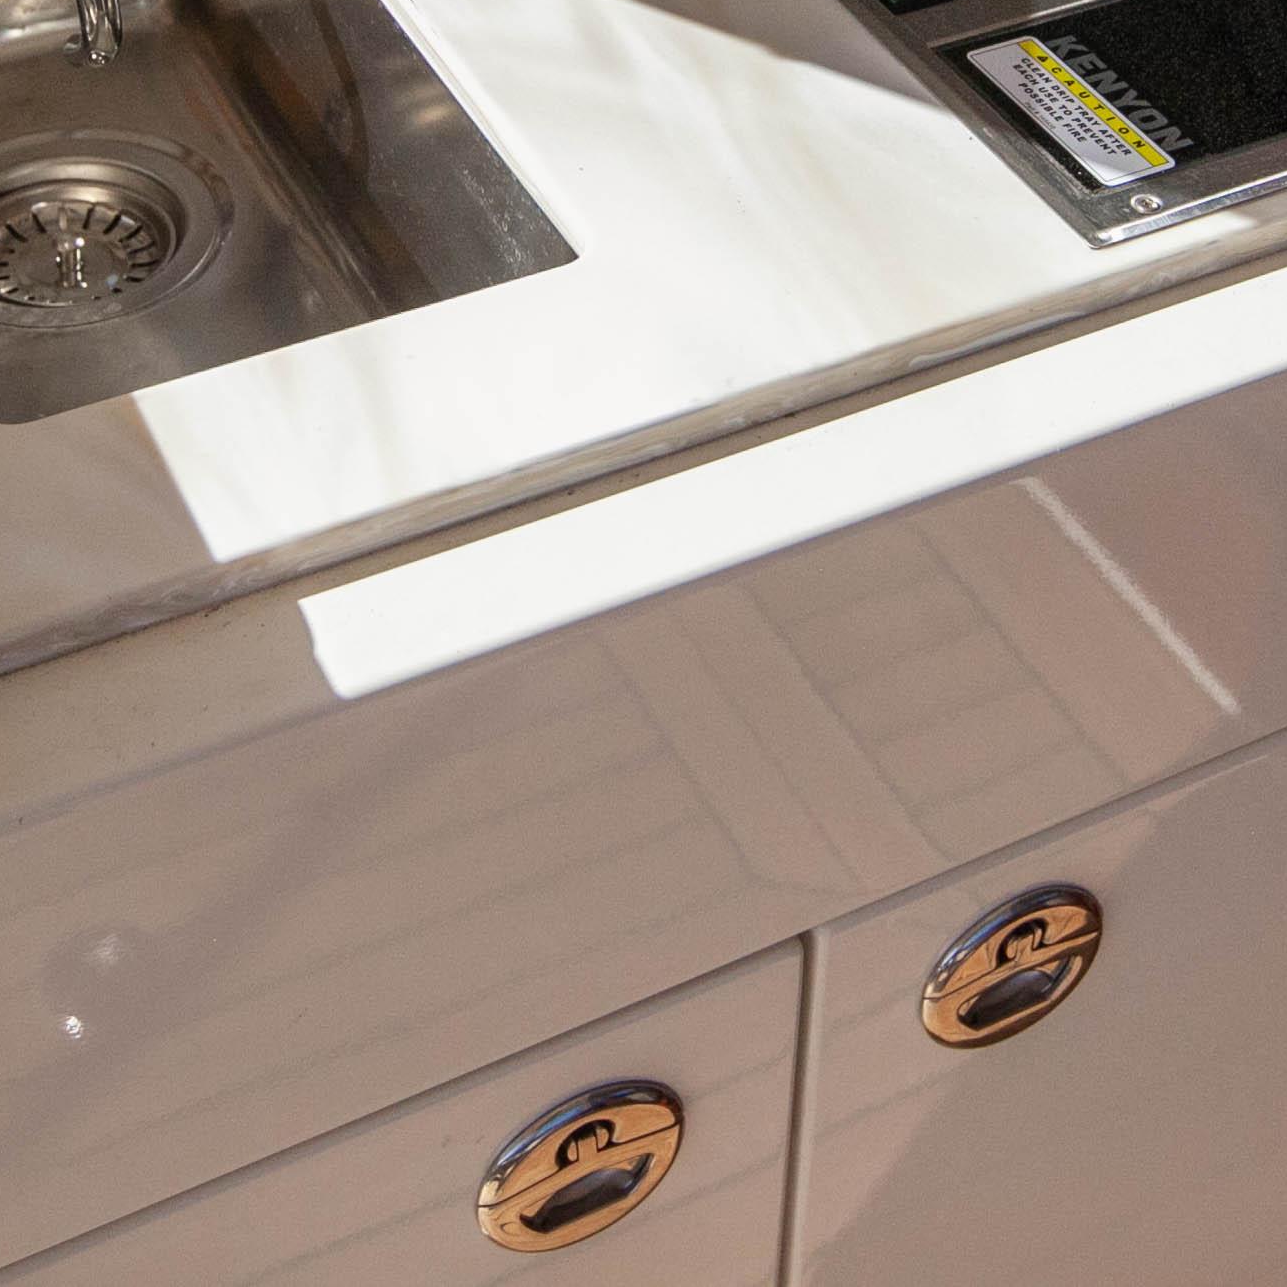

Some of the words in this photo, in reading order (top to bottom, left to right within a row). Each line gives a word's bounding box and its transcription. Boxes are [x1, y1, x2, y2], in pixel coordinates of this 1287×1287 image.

[1013, 64, 1040, 85] EACH
[1038, 87, 1059, 103] USE
[1059, 105, 1073, 116] TO
[1071, 118, 1118, 155] PREVENT
[1017, 82, 1064, 122] POSSIBLE
[1062, 123, 1088, 143] FIRE
[1021, 57, 1053, 84] CLEAN
[1051, 85, 1075, 103] DRIP
[1074, 106, 1101, 126] TRAY
[1099, 129, 1132, 156] AFTER
[1046, 35, 1194, 152] KENYON
[1051, 67, 1146, 148] CAUTION
